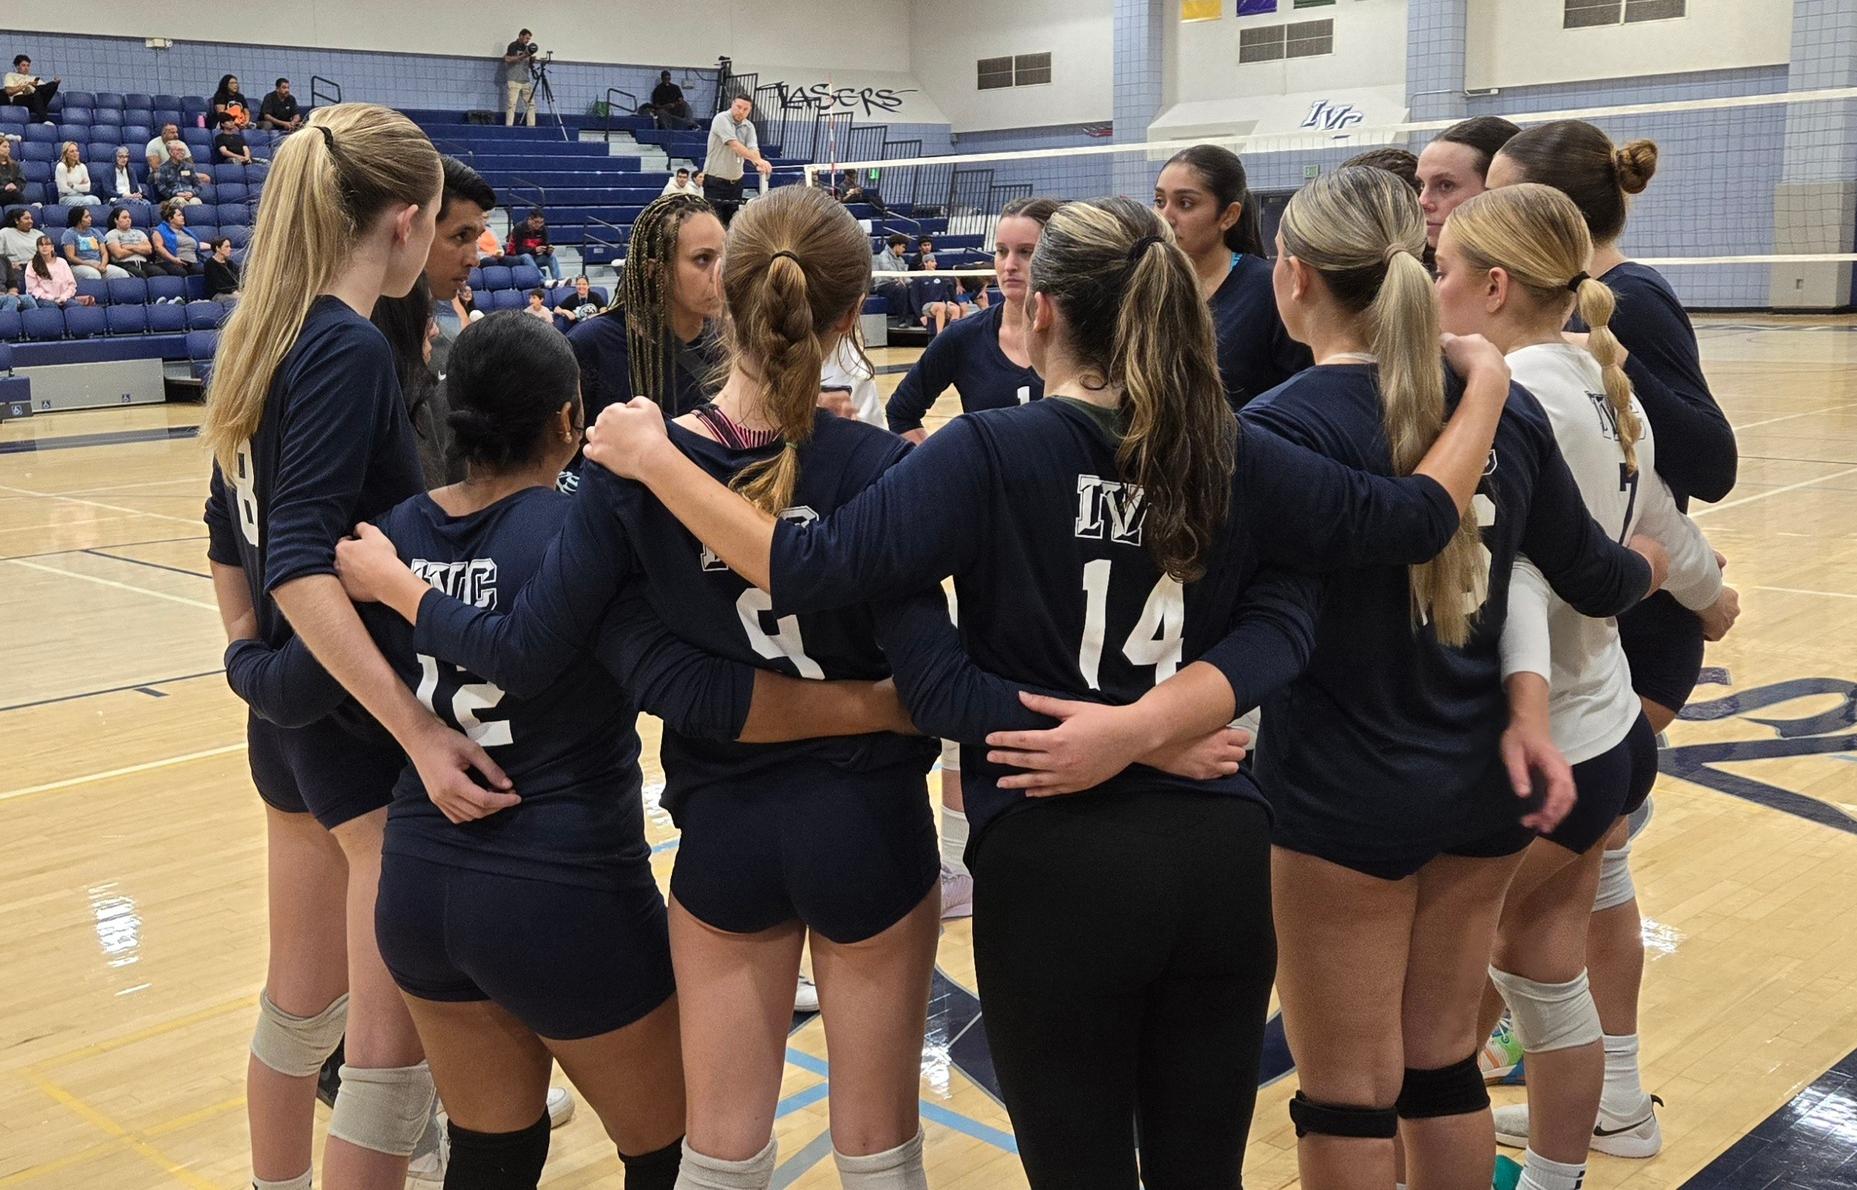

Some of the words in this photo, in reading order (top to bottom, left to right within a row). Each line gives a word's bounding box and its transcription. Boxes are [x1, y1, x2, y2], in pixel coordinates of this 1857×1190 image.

[755, 81, 919, 117] LASERS
[236, 437, 259, 548] 8
[1074, 473, 1152, 547] IV
[1619, 462, 1640, 545] 7
[1079, 558, 1185, 692] 14
